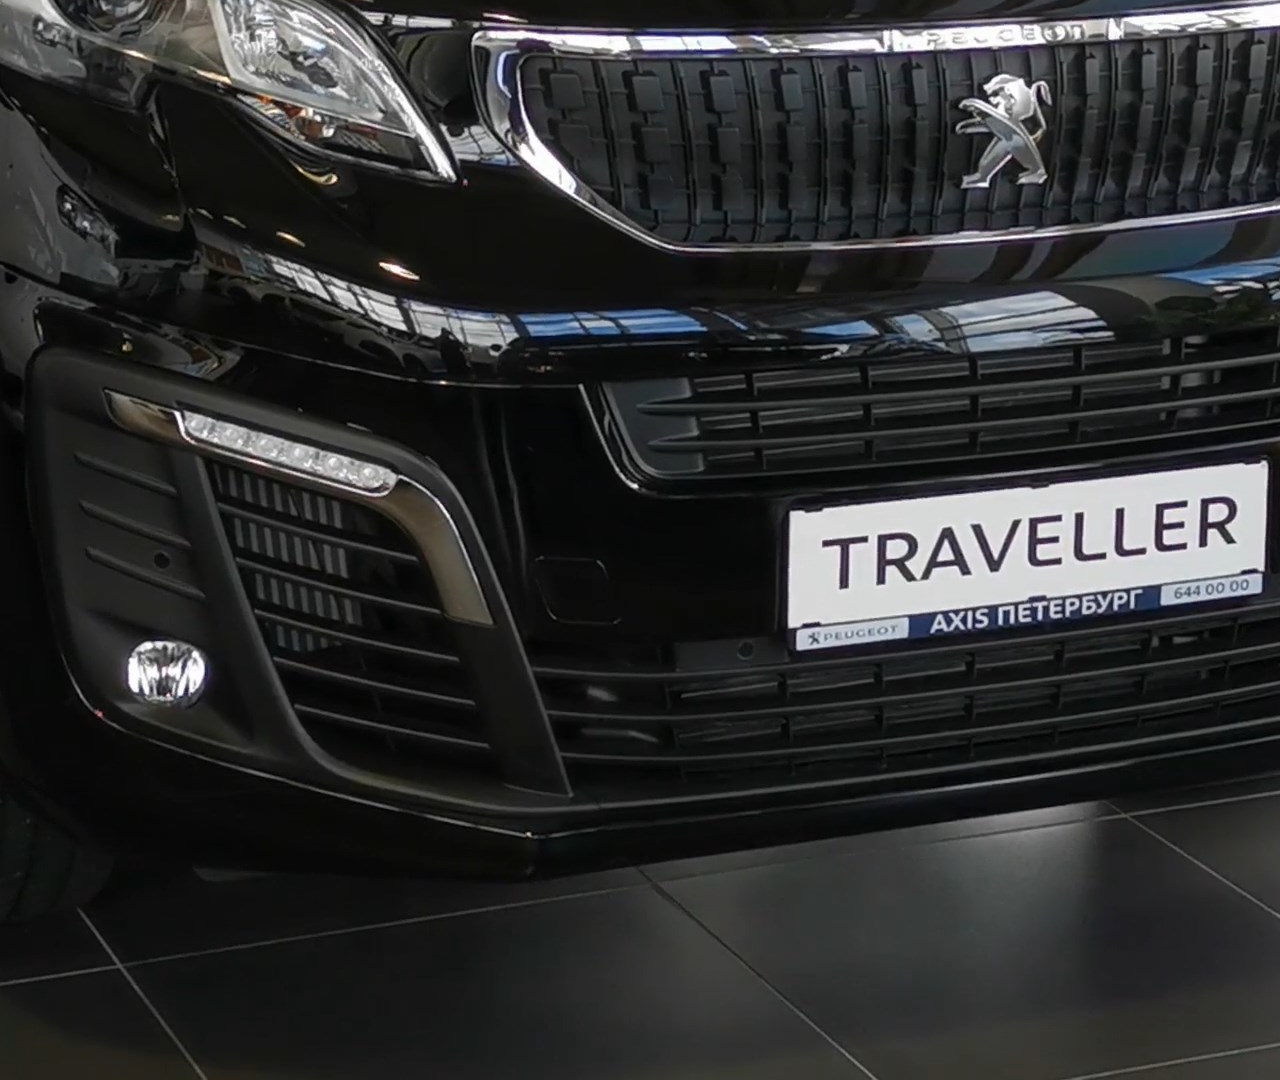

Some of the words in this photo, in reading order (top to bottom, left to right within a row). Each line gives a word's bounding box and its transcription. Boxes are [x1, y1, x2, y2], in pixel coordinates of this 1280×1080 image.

[821, 495, 1239, 591] TRAVELLER
[1173, 586, 1201, 600] 644
[1205, 582, 1225, 596] 00
[1229, 578, 1250, 592] 00
[929, 608, 989, 635] AXIS
[997, 589, 1144, 626] ПЕТЕРБУРГ
[823, 625, 899, 642] PEUGEOT
